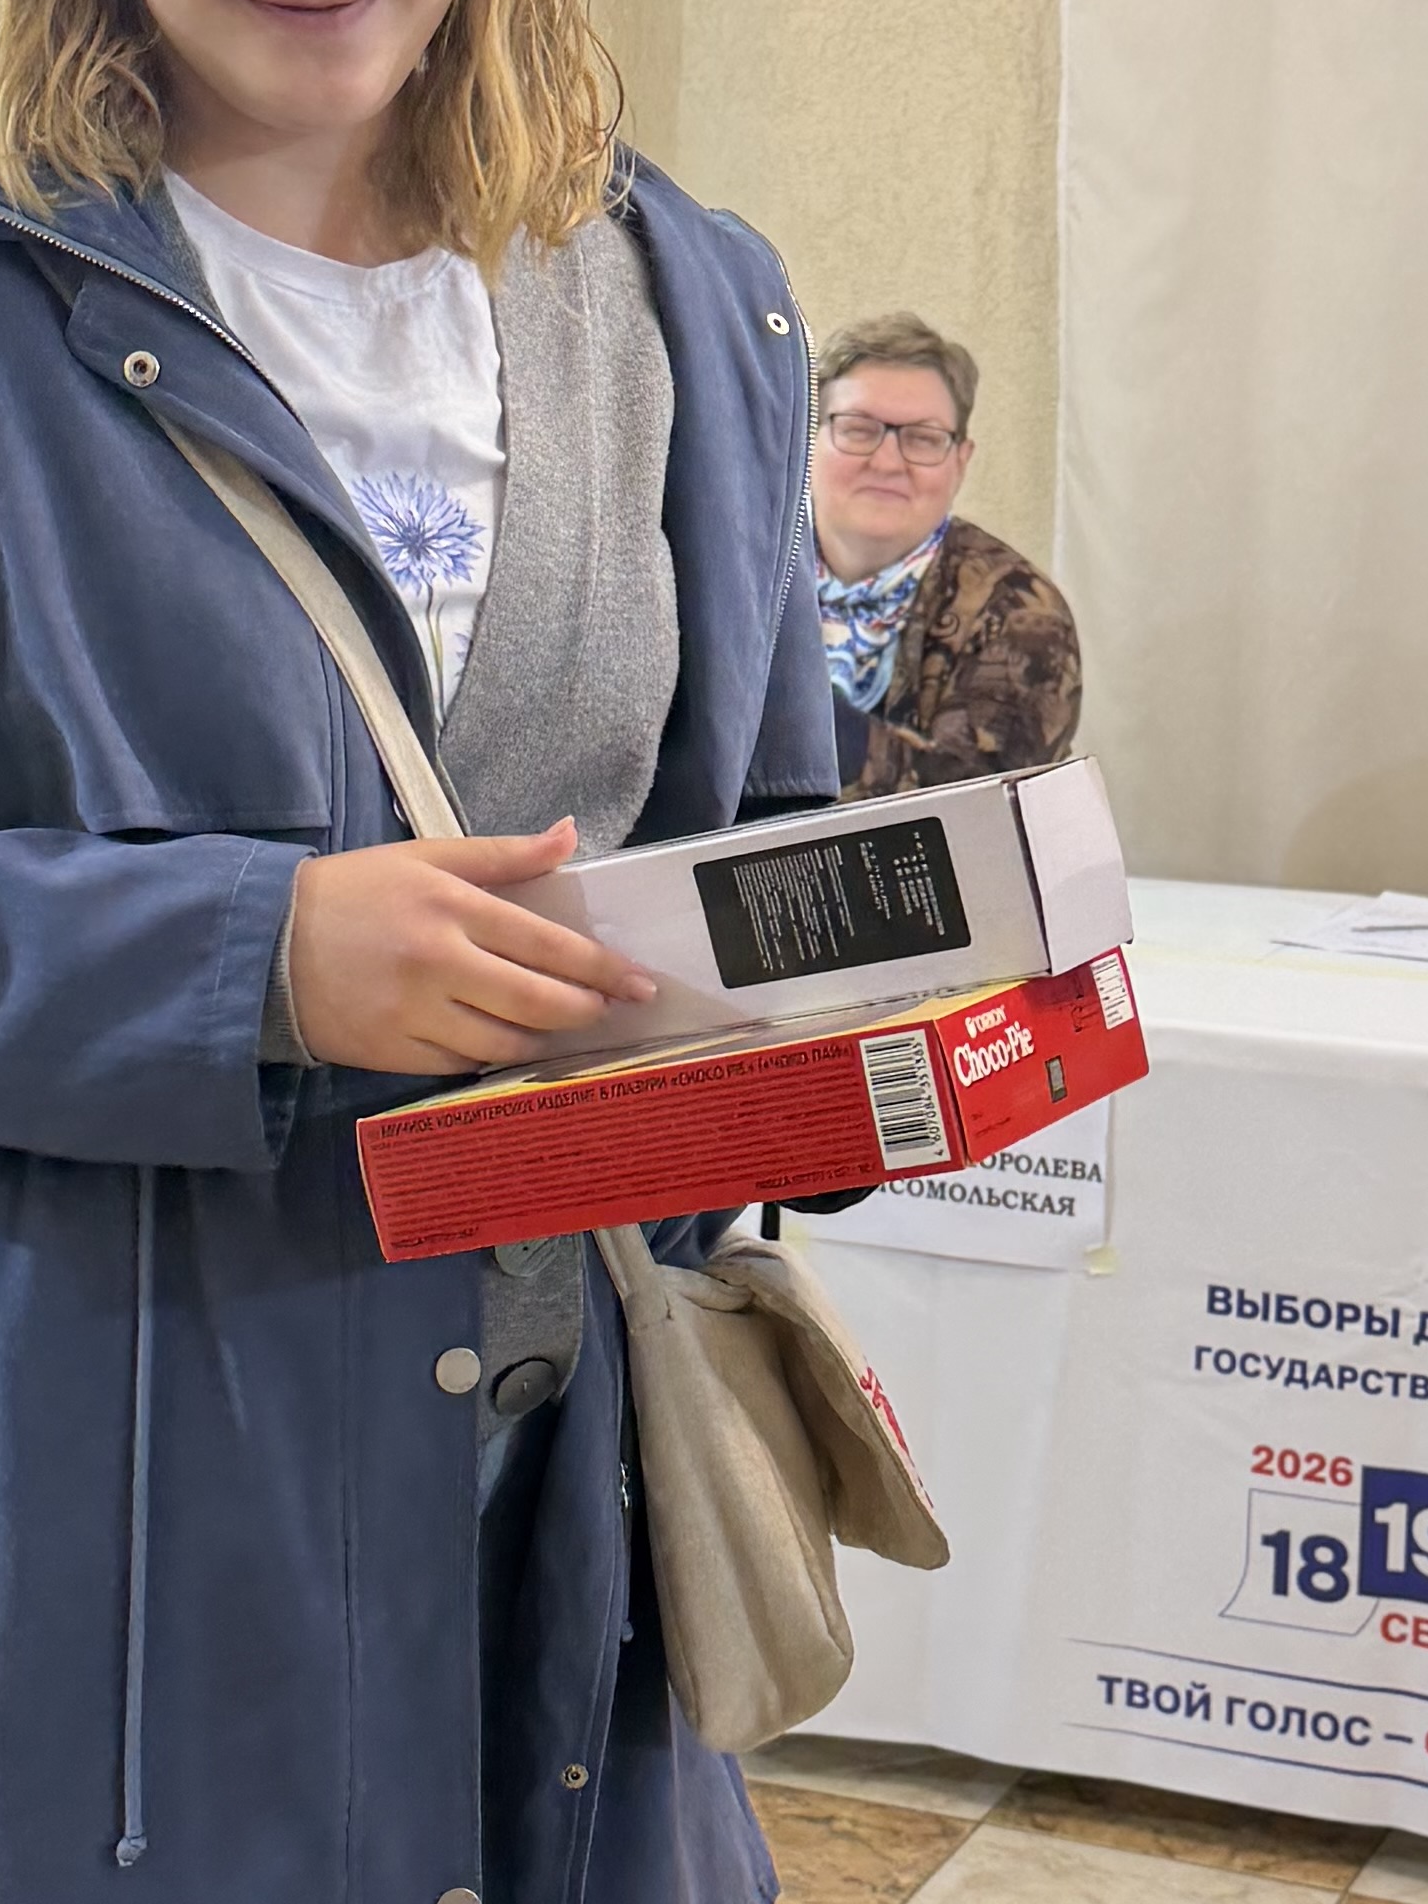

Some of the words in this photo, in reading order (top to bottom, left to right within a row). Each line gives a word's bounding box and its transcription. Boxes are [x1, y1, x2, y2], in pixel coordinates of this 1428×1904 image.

[970, 1152, 1103, 1184] ОРОЛЕВА
[879, 1178, 1076, 1217] СОМОЛЬСКАЯ
[1205, 1284, 1401, 1340] ВЫБОРЫ
[1250, 1444, 1353, 1487] 2026
[1260, 1528, 1351, 1604] 18
[1096, 1673, 1212, 1722] ТВОЙ
[1225, 1698, 1372, 1748] ГОЛОС
